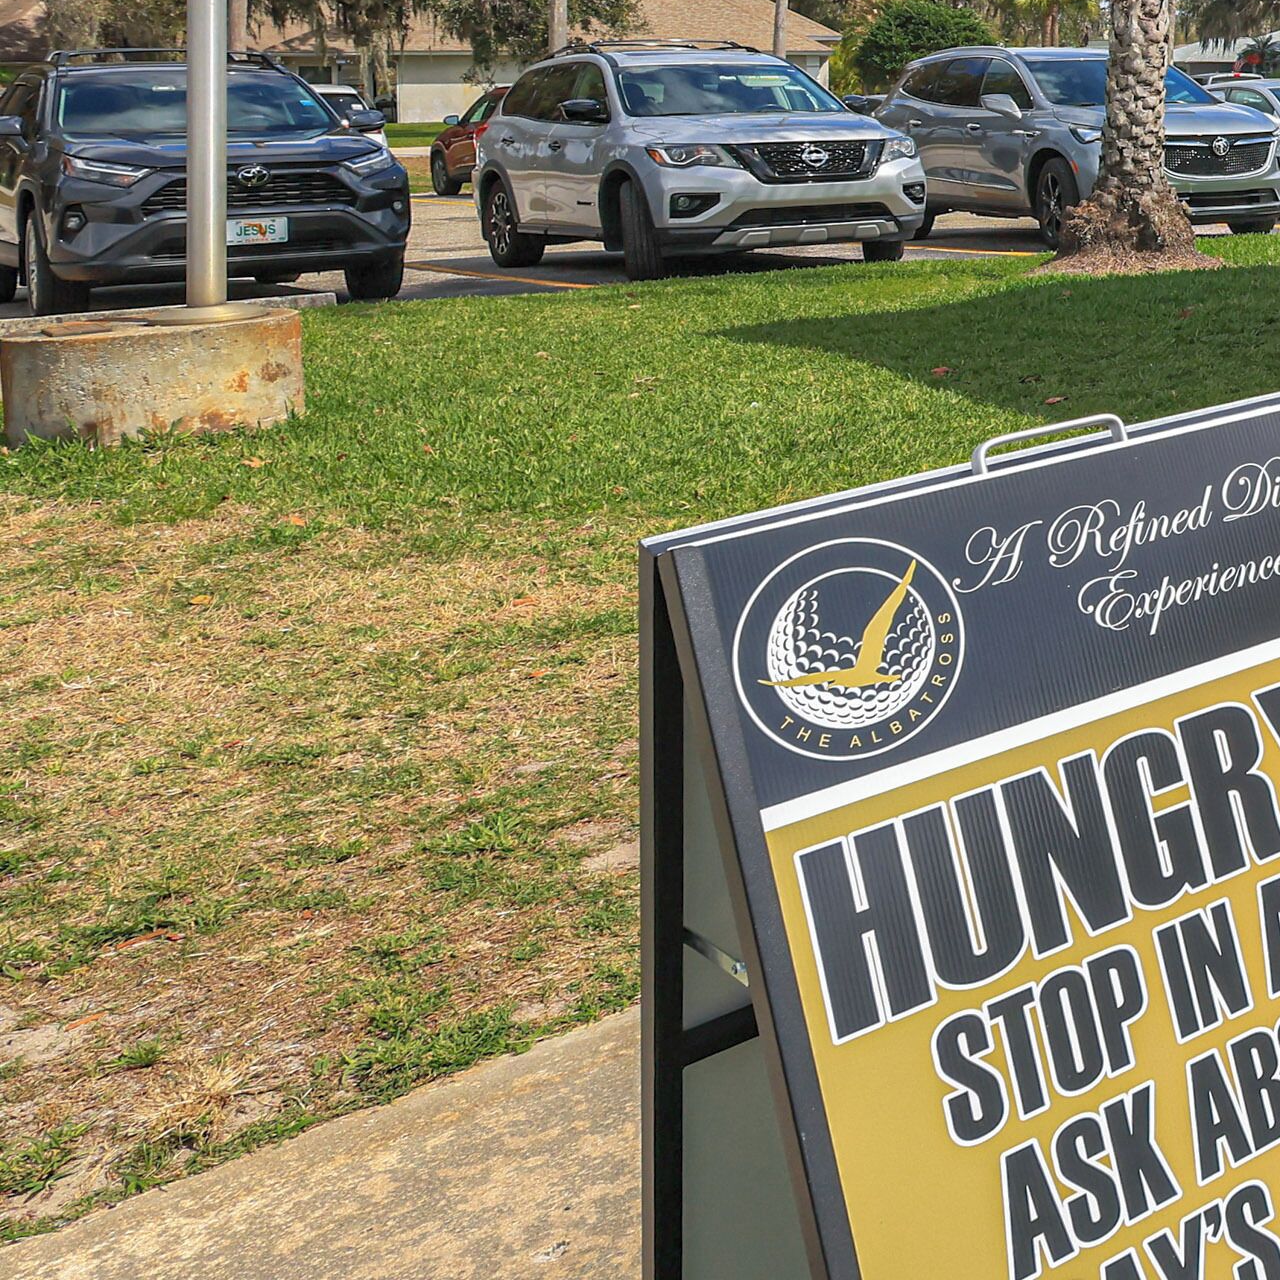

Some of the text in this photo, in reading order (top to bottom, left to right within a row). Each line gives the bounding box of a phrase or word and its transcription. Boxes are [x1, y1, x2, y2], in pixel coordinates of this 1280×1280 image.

[236, 224, 276, 237] JESUS
[952, 520, 1043, 594] A
[1047, 484, 1213, 573] Refined
[780, 612, 954, 749] THE ALBATROSS
[933, 944, 1144, 1145] STOP
[1154, 899, 1253, 1042] IN
[998, 1080, 1184, 1280] ASK
